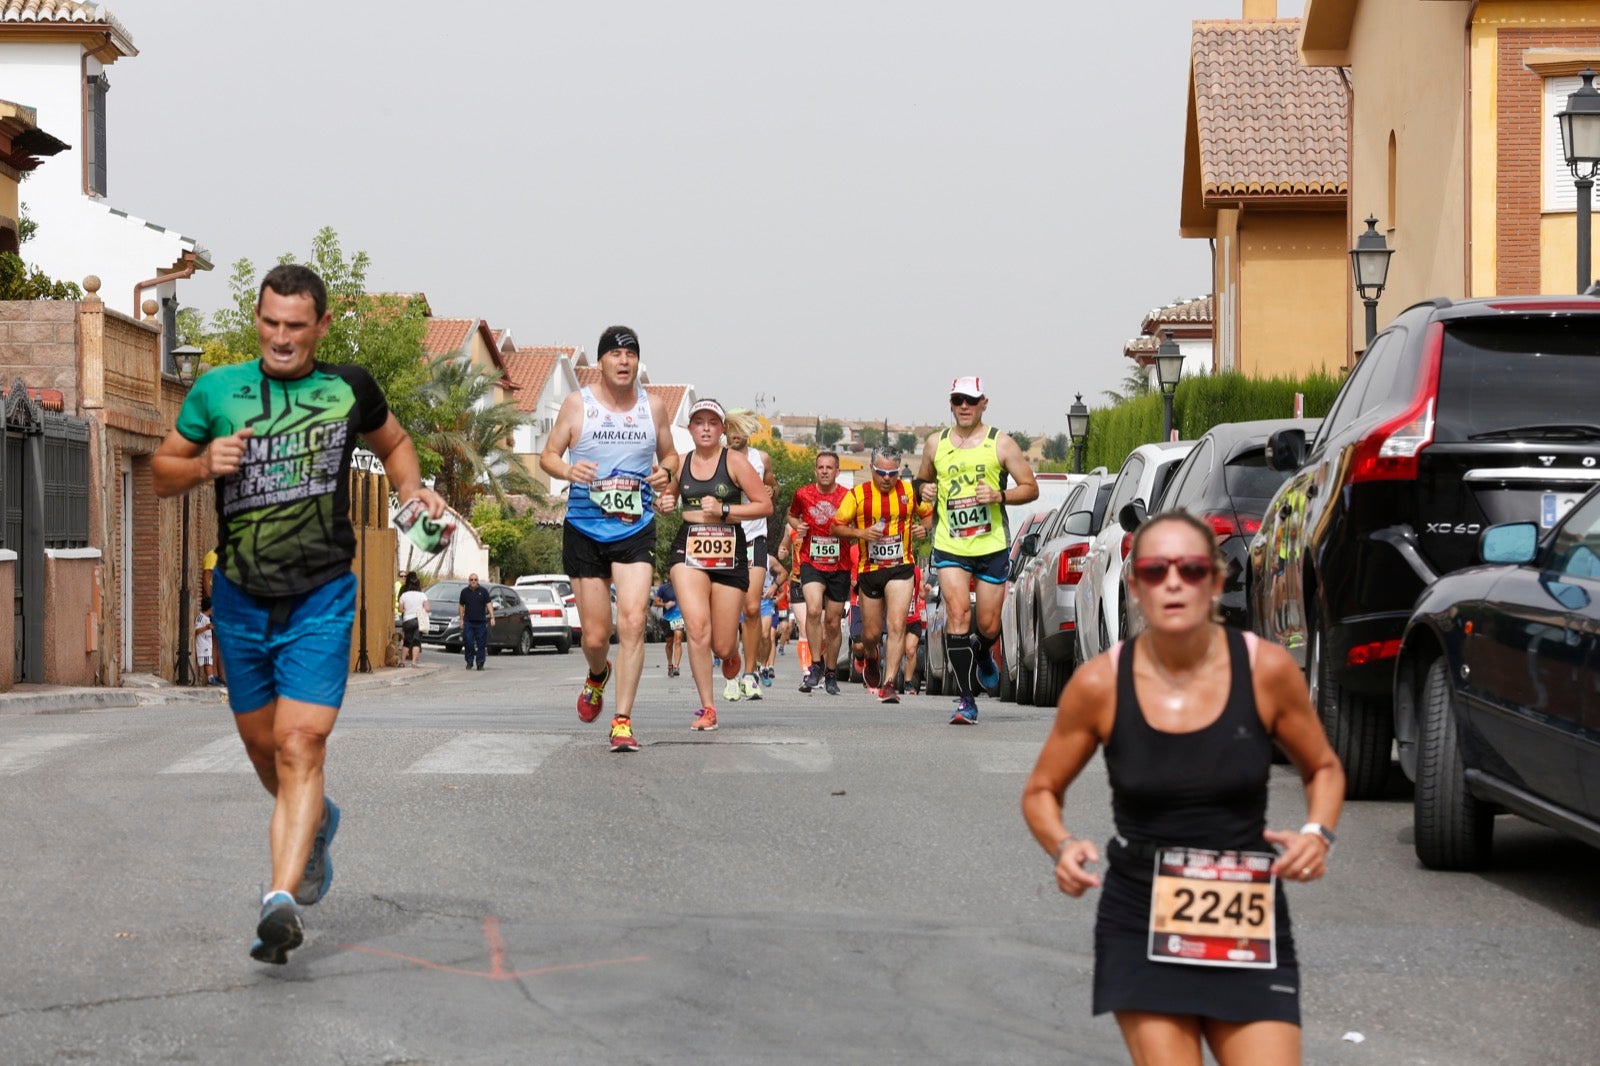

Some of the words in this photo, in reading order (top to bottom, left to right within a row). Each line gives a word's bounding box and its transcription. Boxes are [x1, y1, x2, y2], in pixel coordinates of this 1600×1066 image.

[592, 430, 647, 440] MARACENA
[600, 492, 634, 510] 464
[950, 506, 988, 526] 1041
[693, 540, 732, 554] 2093
[815, 545, 835, 555] 156
[872, 544, 901, 556] 3057
[1172, 888, 1265, 927] 2245
